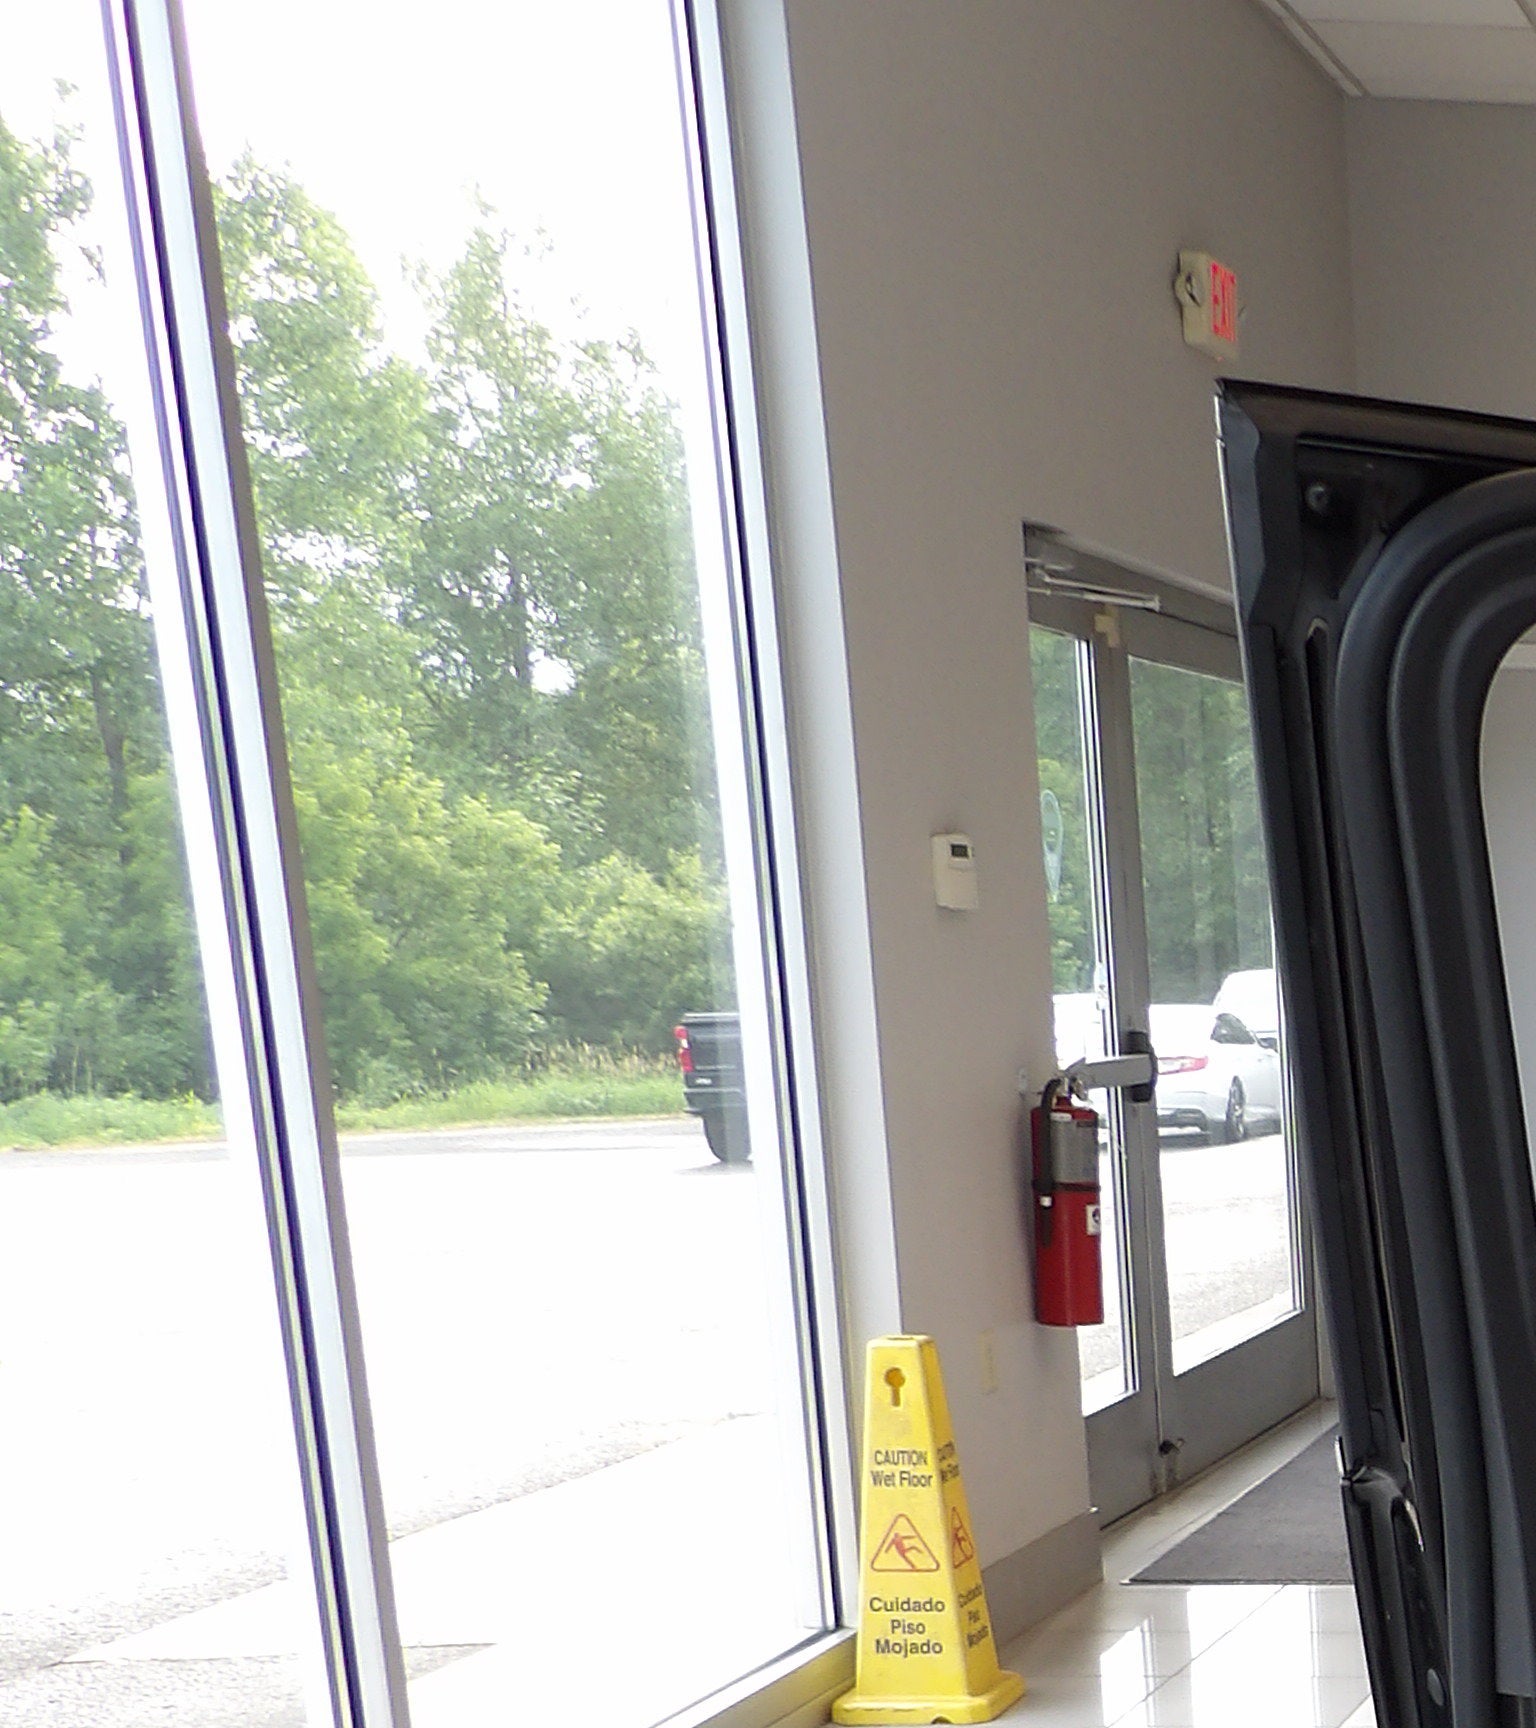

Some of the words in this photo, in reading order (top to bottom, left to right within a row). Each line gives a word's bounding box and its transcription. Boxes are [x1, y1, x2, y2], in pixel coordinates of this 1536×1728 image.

[874, 1449, 928, 1466] CAUTION
[870, 1470, 896, 1487] Wet
[899, 1470, 933, 1488] Floor
[869, 1596, 946, 1613] Cuidado
[890, 1618, 926, 1635] Piso
[875, 1638, 943, 1659] Mojado
